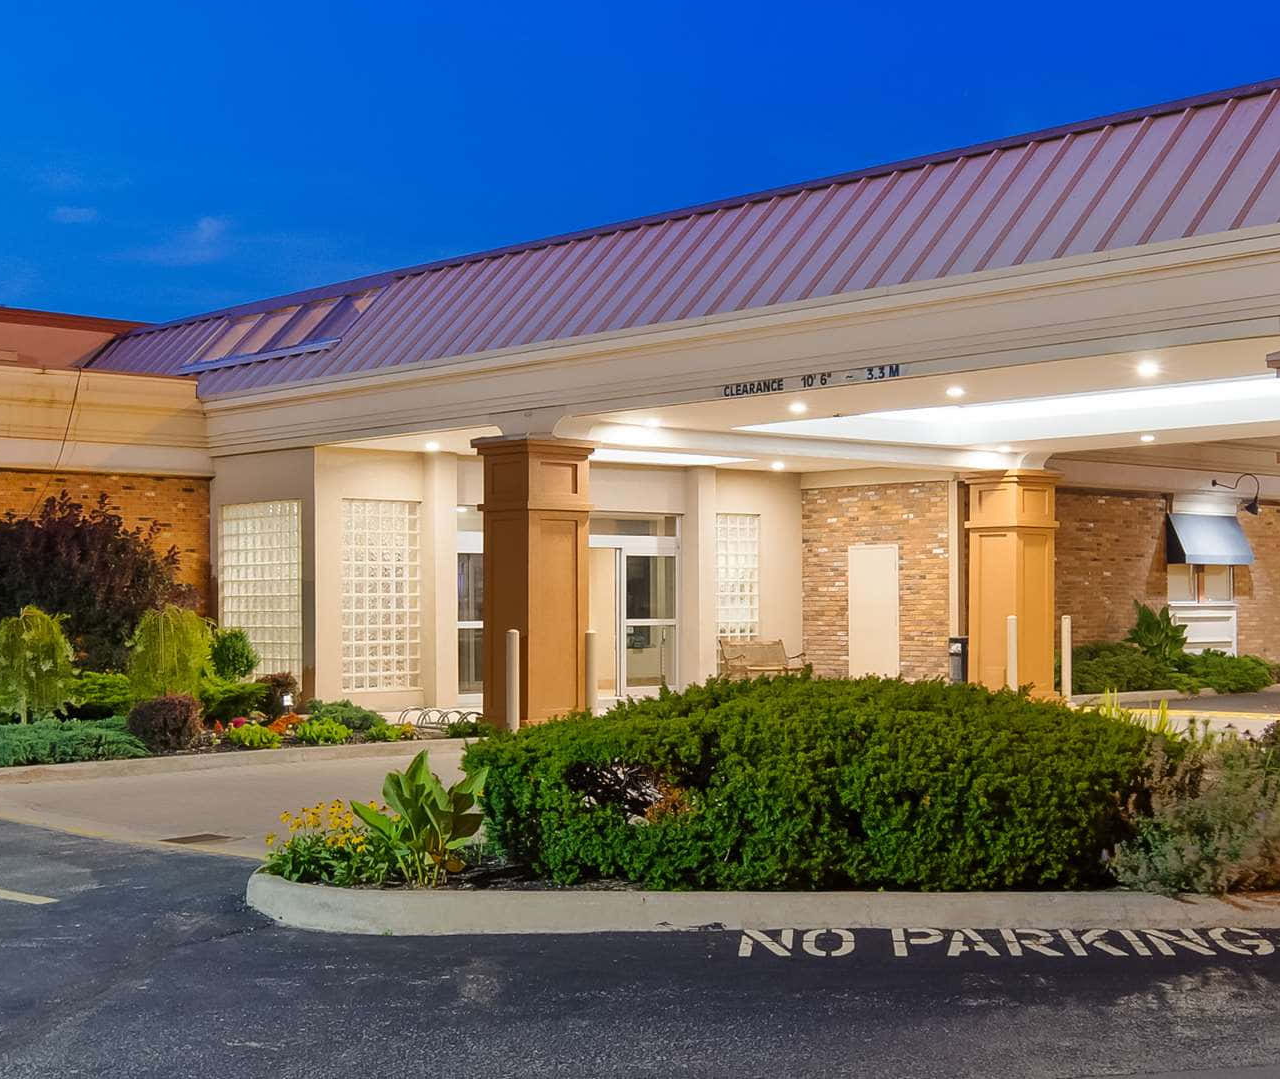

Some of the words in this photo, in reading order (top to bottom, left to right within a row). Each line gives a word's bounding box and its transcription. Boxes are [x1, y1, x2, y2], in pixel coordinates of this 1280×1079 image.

[723, 379, 784, 397] CLEARANCE
[801, 374, 816, 388] 10'
[866, 366, 885, 381] 3.3
[889, 364, 899, 377] M
[738, 928, 855, 957] NO
[891, 927, 1275, 957] PARKING
